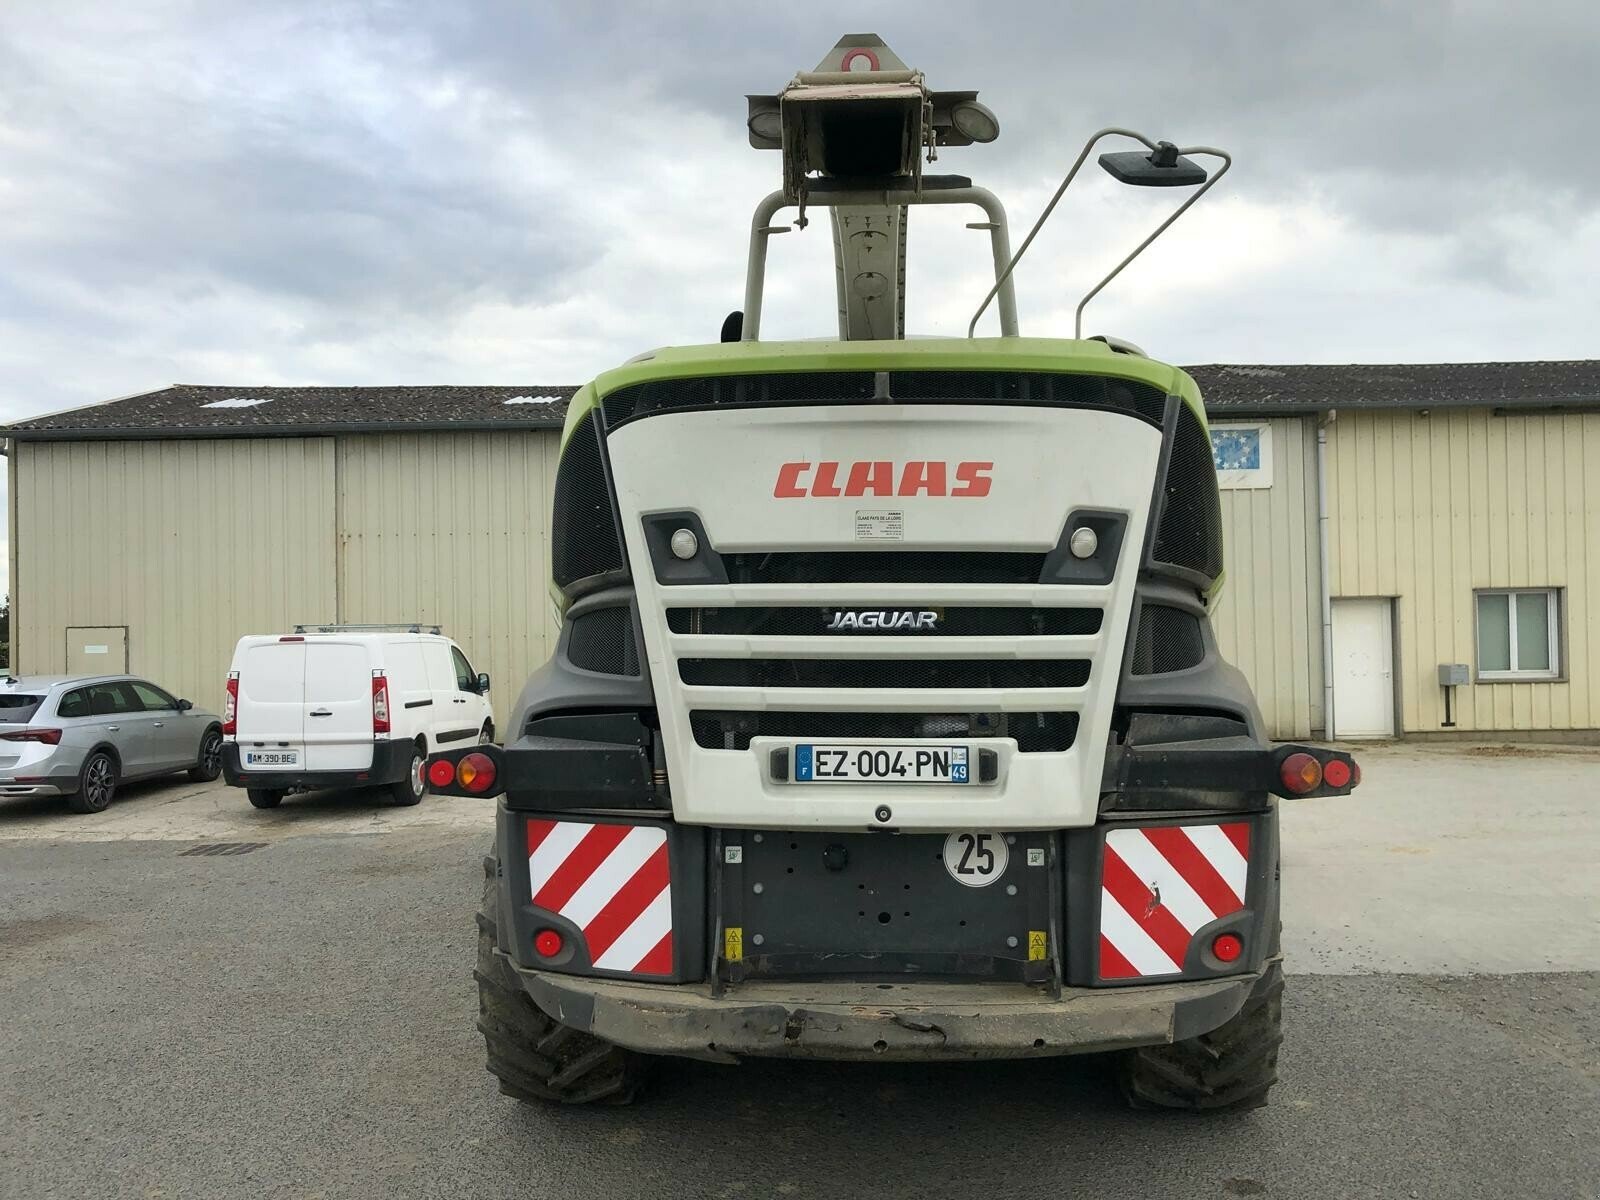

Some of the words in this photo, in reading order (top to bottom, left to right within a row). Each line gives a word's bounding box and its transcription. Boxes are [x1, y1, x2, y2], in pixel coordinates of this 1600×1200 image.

[773, 461, 994, 498] CLAAS
[827, 611, 938, 629] JAGUAR
[802, 767, 808, 776] F
[952, 765, 967, 779] 49
[957, 833, 995, 875] 25
